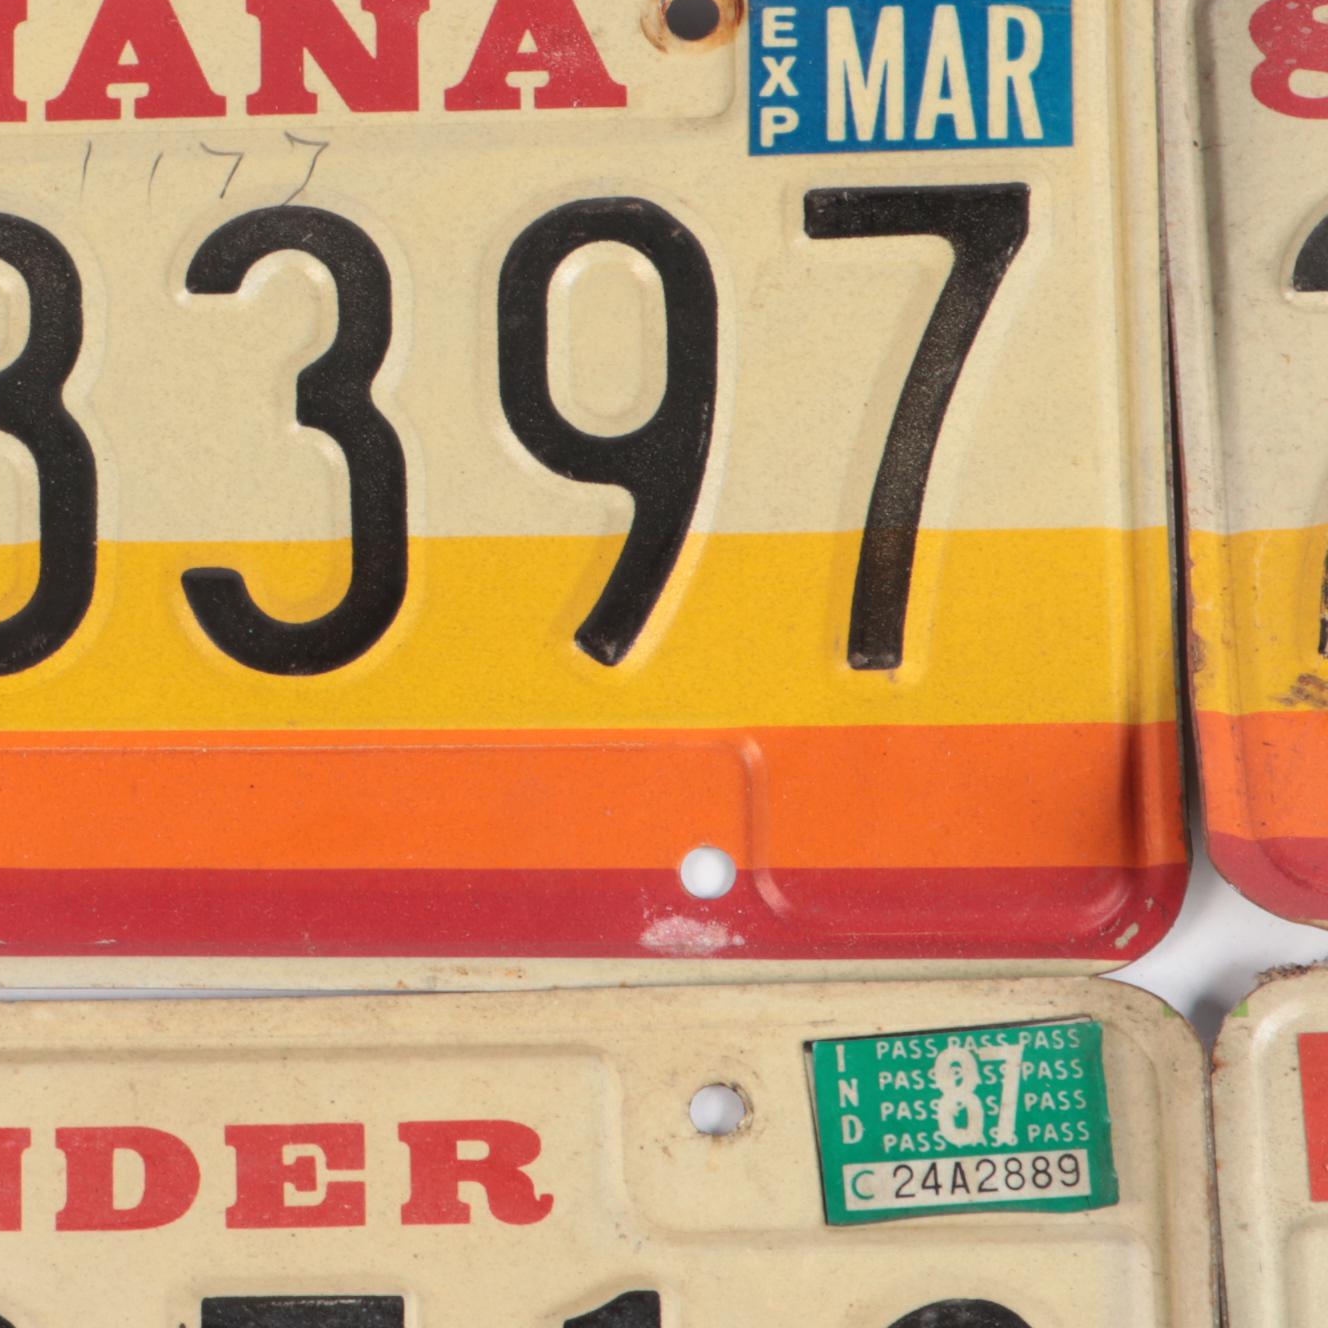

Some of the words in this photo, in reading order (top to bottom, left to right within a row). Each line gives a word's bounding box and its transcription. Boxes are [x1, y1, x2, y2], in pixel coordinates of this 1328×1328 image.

[759, 7, 799, 147] EXP
[826, 4, 1043, 141] MAR
[876, 1038, 939, 1060] PASS
[1019, 1028, 1081, 1051] PASS
[1022, 1060, 1084, 1081] PASS
[835, 1044, 864, 1145] IND
[934, 1043, 1024, 1148] 87
[1024, 1089, 1088, 1112] PASS
[883, 1131, 947, 1153] PASS
[1027, 1121, 1090, 1143] PASS
[850, 1169, 876, 1200] C
[892, 1153, 1082, 1199] 24A2889
